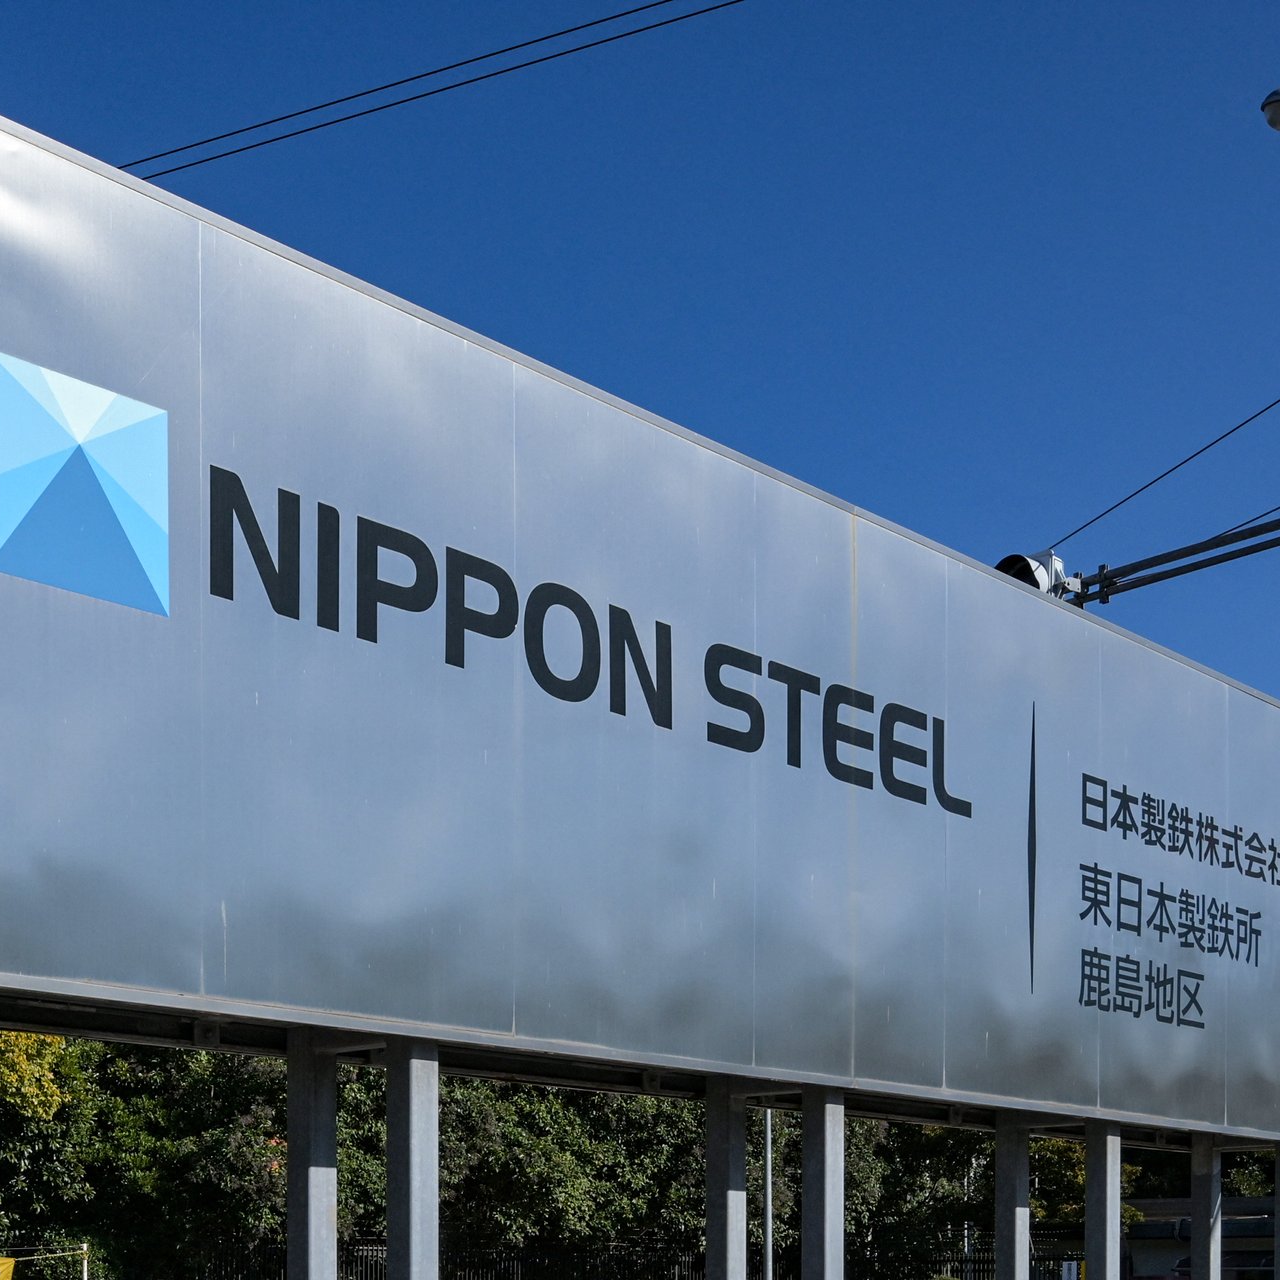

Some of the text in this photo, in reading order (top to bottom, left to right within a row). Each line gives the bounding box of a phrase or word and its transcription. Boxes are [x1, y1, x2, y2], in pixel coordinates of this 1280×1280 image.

[209, 465, 972, 817] NIPPON STEEL
[1079, 862, 1262, 967] 東日本製鉄所
[1078, 947, 1205, 1029] 鹿島地区
